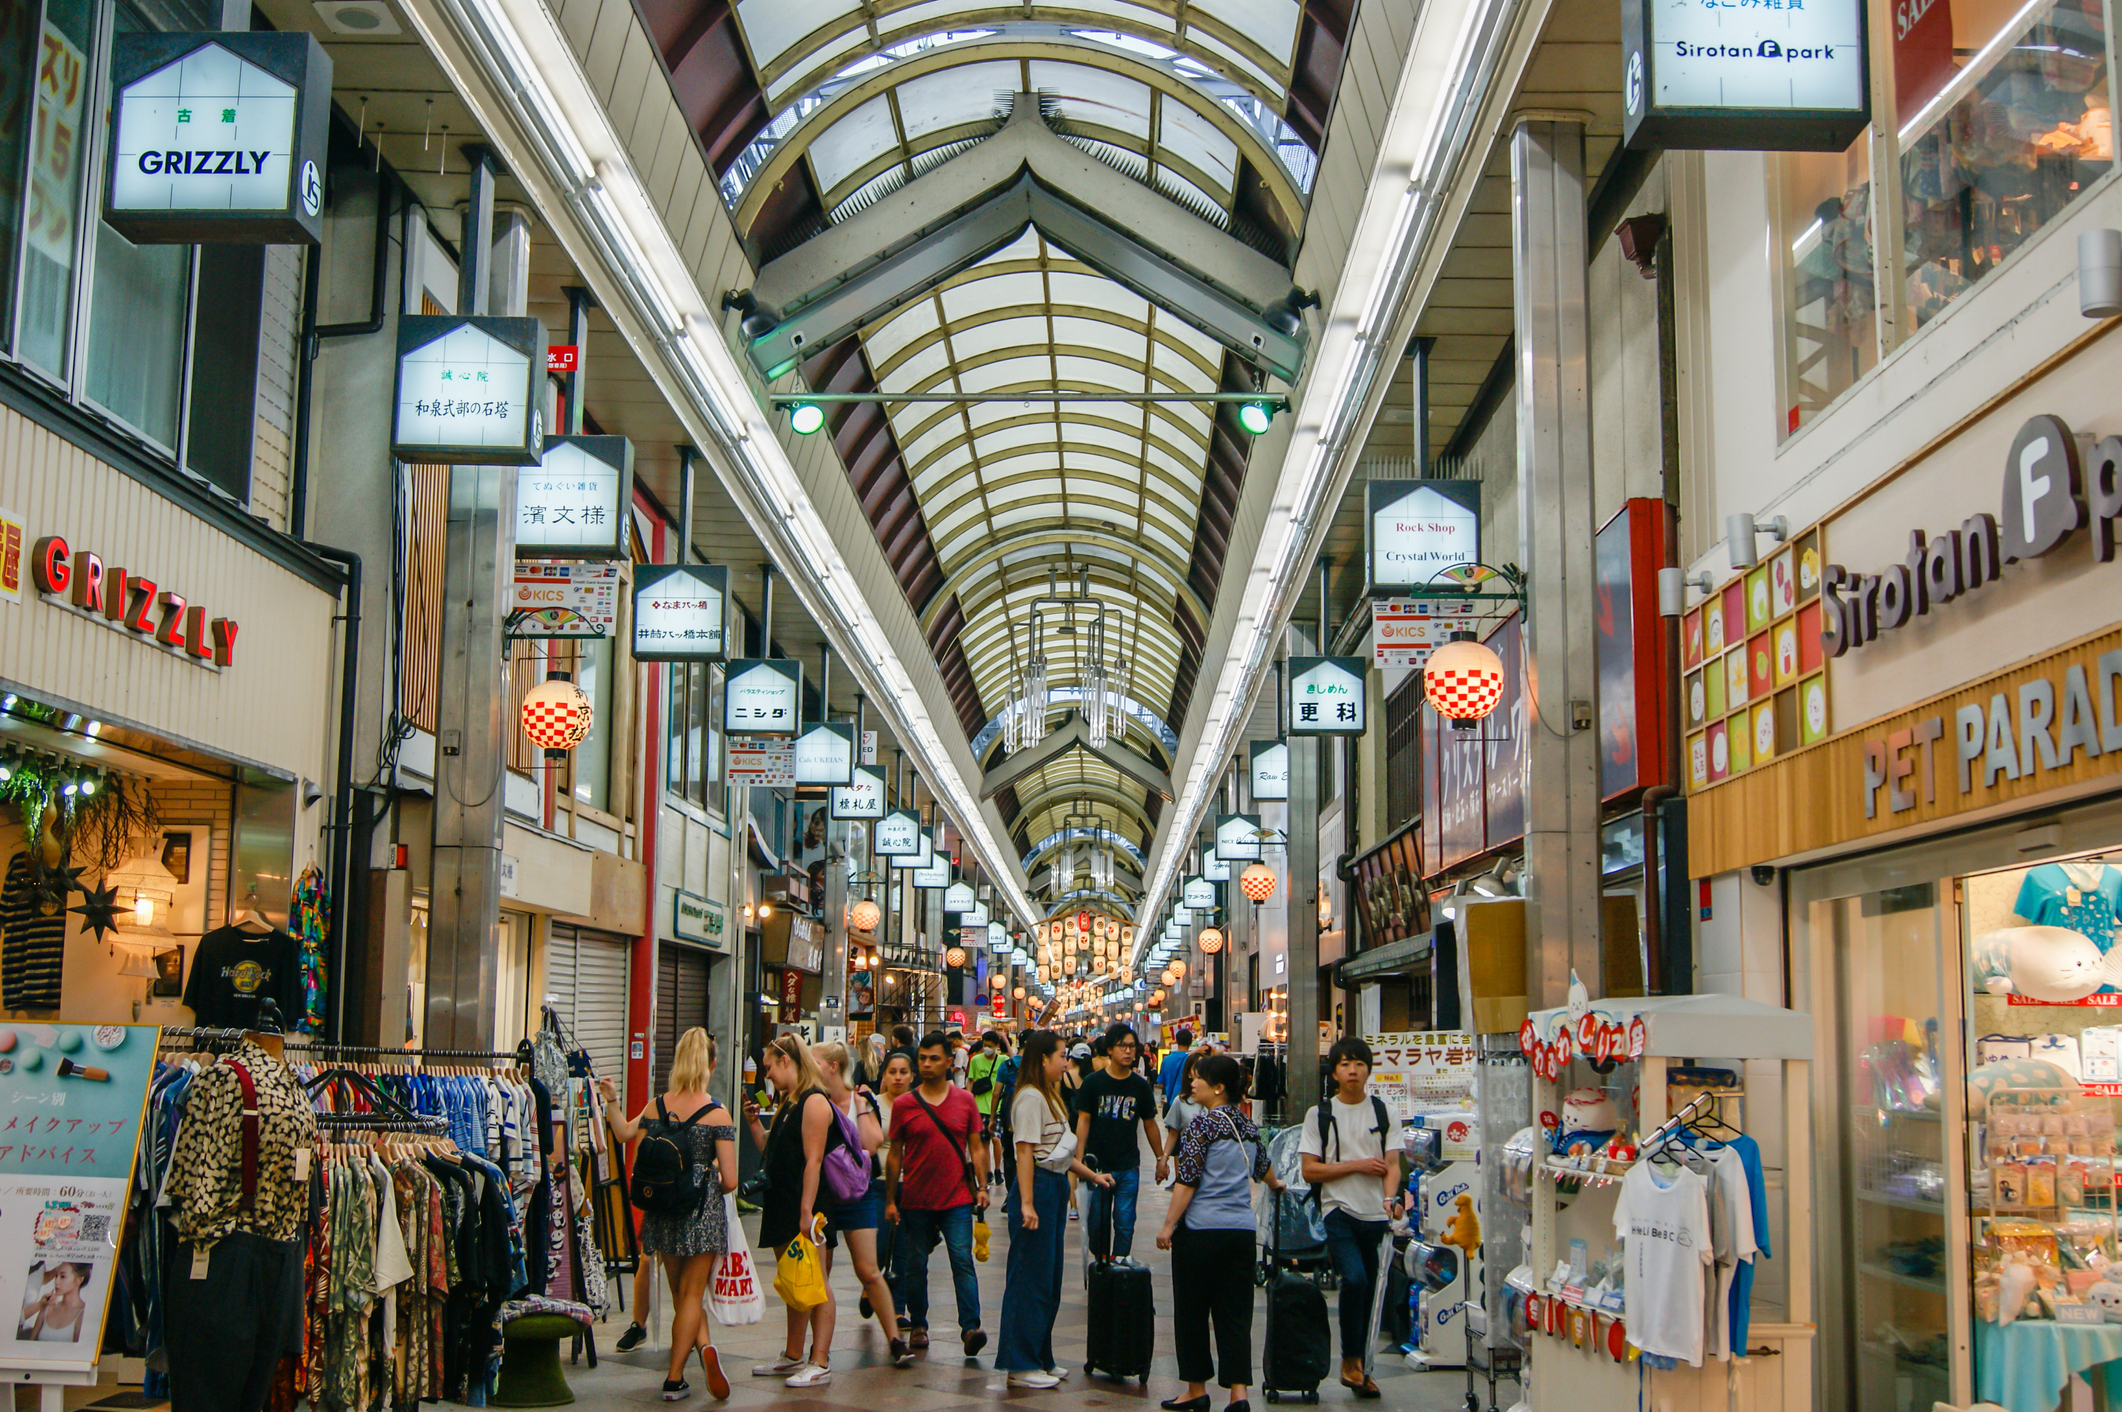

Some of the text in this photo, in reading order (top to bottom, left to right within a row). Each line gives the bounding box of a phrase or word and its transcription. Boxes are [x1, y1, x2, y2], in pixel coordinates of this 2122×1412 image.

[1676, 40, 1753, 58] Sirotan
[1786, 44, 1835, 62] park
[177, 108, 237, 123] 古着
[138, 150, 271, 175] GRIZZLY
[440, 370, 490, 382] 誠心院
[414, 398, 510, 419] 和泉式部の石塔
[533, 481, 598, 491] てぬぐい雑貨
[522, 504, 605, 525] 濱文様
[1396, 522, 1456, 535] Rock Shop
[1386, 551, 1465, 563] Crystal World
[1820, 513, 2000, 658] Sirotan
[32, 536, 238, 667] GRIZZLY
[533, 590, 564, 601] KICS
[1395, 627, 1425, 637] KICS
[1306, 684, 1348, 694] きしめん
[735, 708, 787, 718] ニシダ
[1299, 702, 1356, 722] 更科
[742, 758, 762, 766] KICS
[1864, 716, 1942, 819] PET
[838, 798, 877, 811] 標札屋
[882, 837, 912, 847] 誠心院
[221, 965, 272, 982] Hard Rock
[2087, 995, 2118, 1005] SALE
[11, 1091, 67, 1106] シーン別
[1098, 1096, 1137, 1120] NYC
[1, 1115, 127, 1136] メイクアップ
[0, 1145, 97, 1165] アドバイス
[715, 1277, 754, 1297] MART
[2060, 1307, 2099, 1320] NEW
